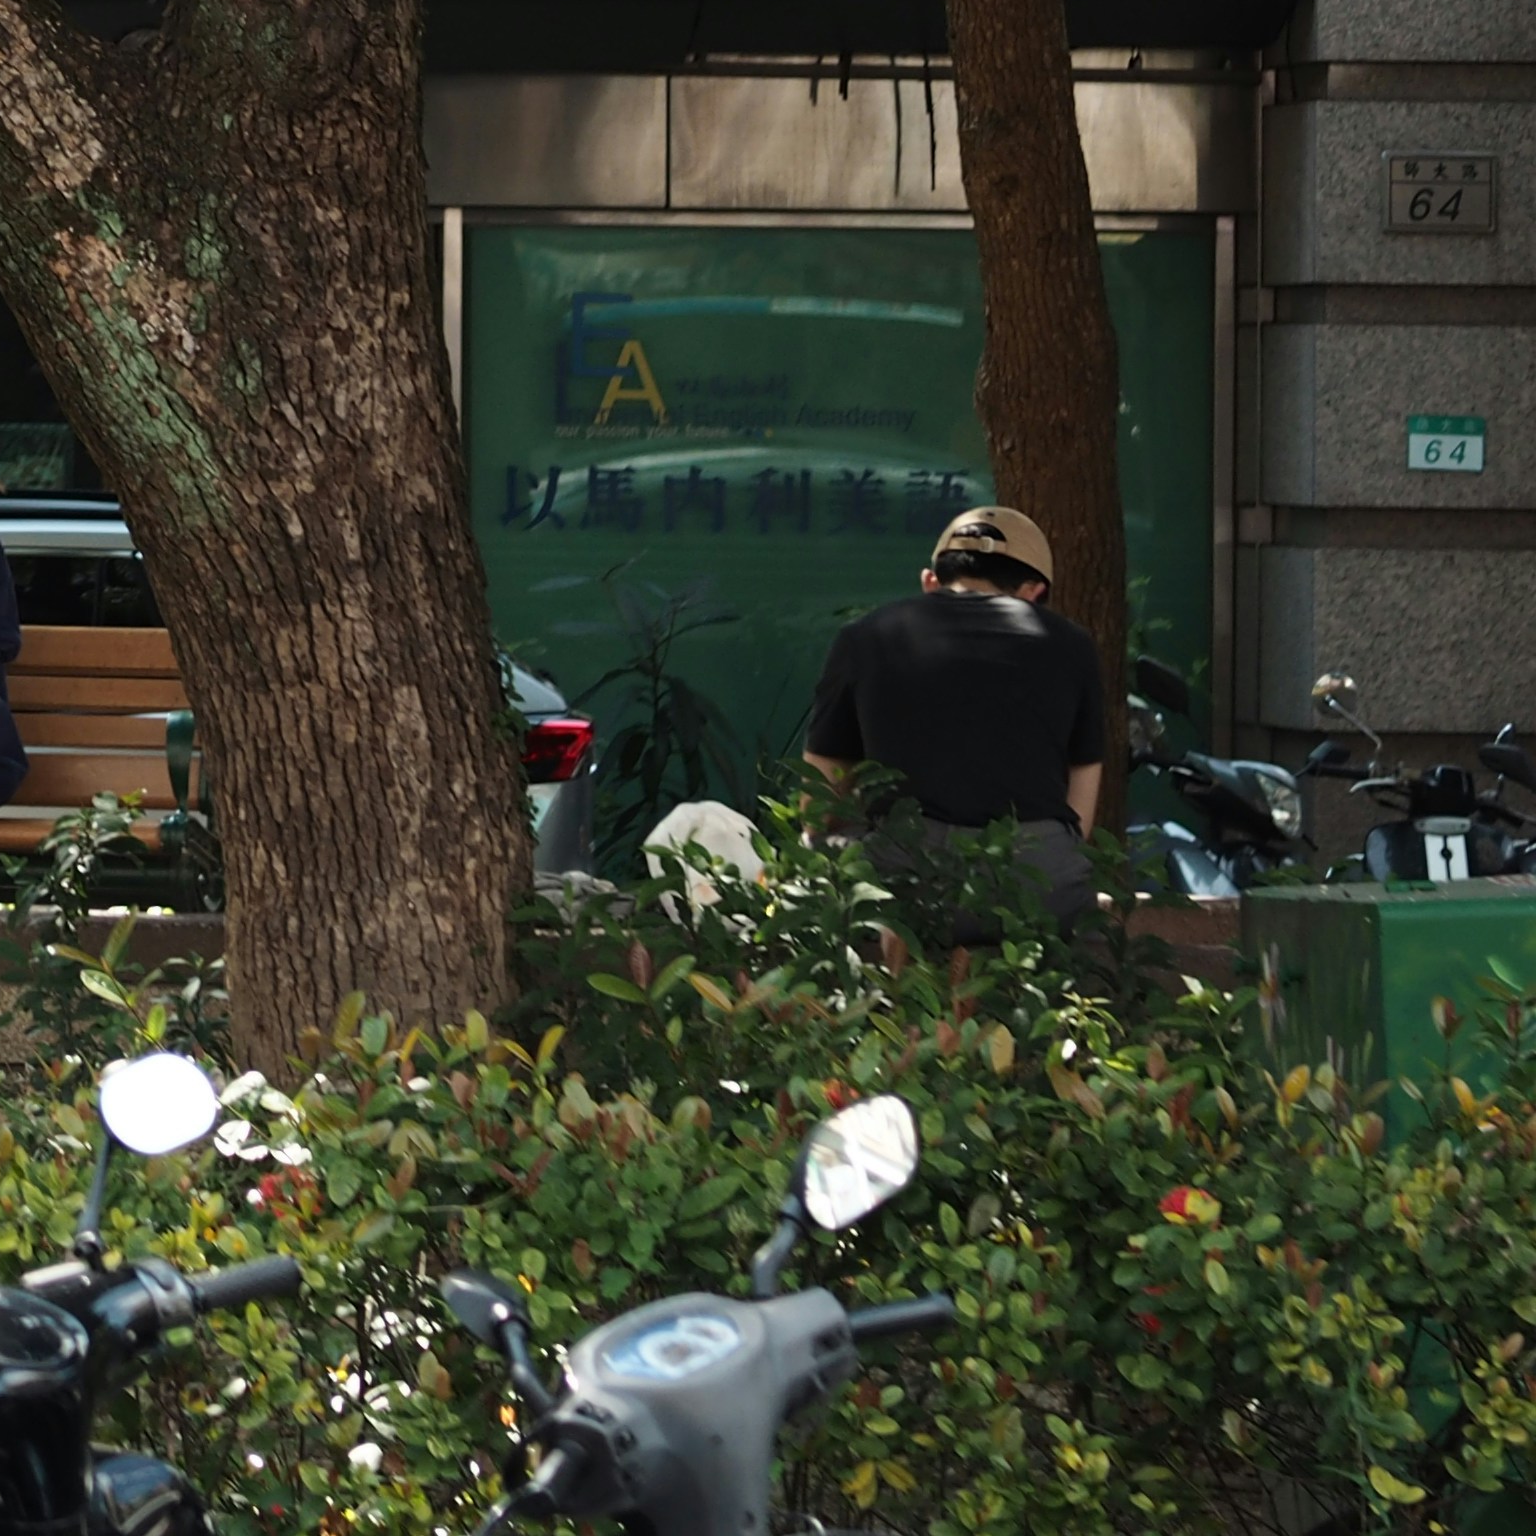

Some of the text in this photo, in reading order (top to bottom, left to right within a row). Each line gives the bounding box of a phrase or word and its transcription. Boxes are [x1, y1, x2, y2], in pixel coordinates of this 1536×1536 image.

[1409, 188, 1463, 221] 64
[796, 402, 917, 432] Academy
[1424, 439, 1467, 464] 64
